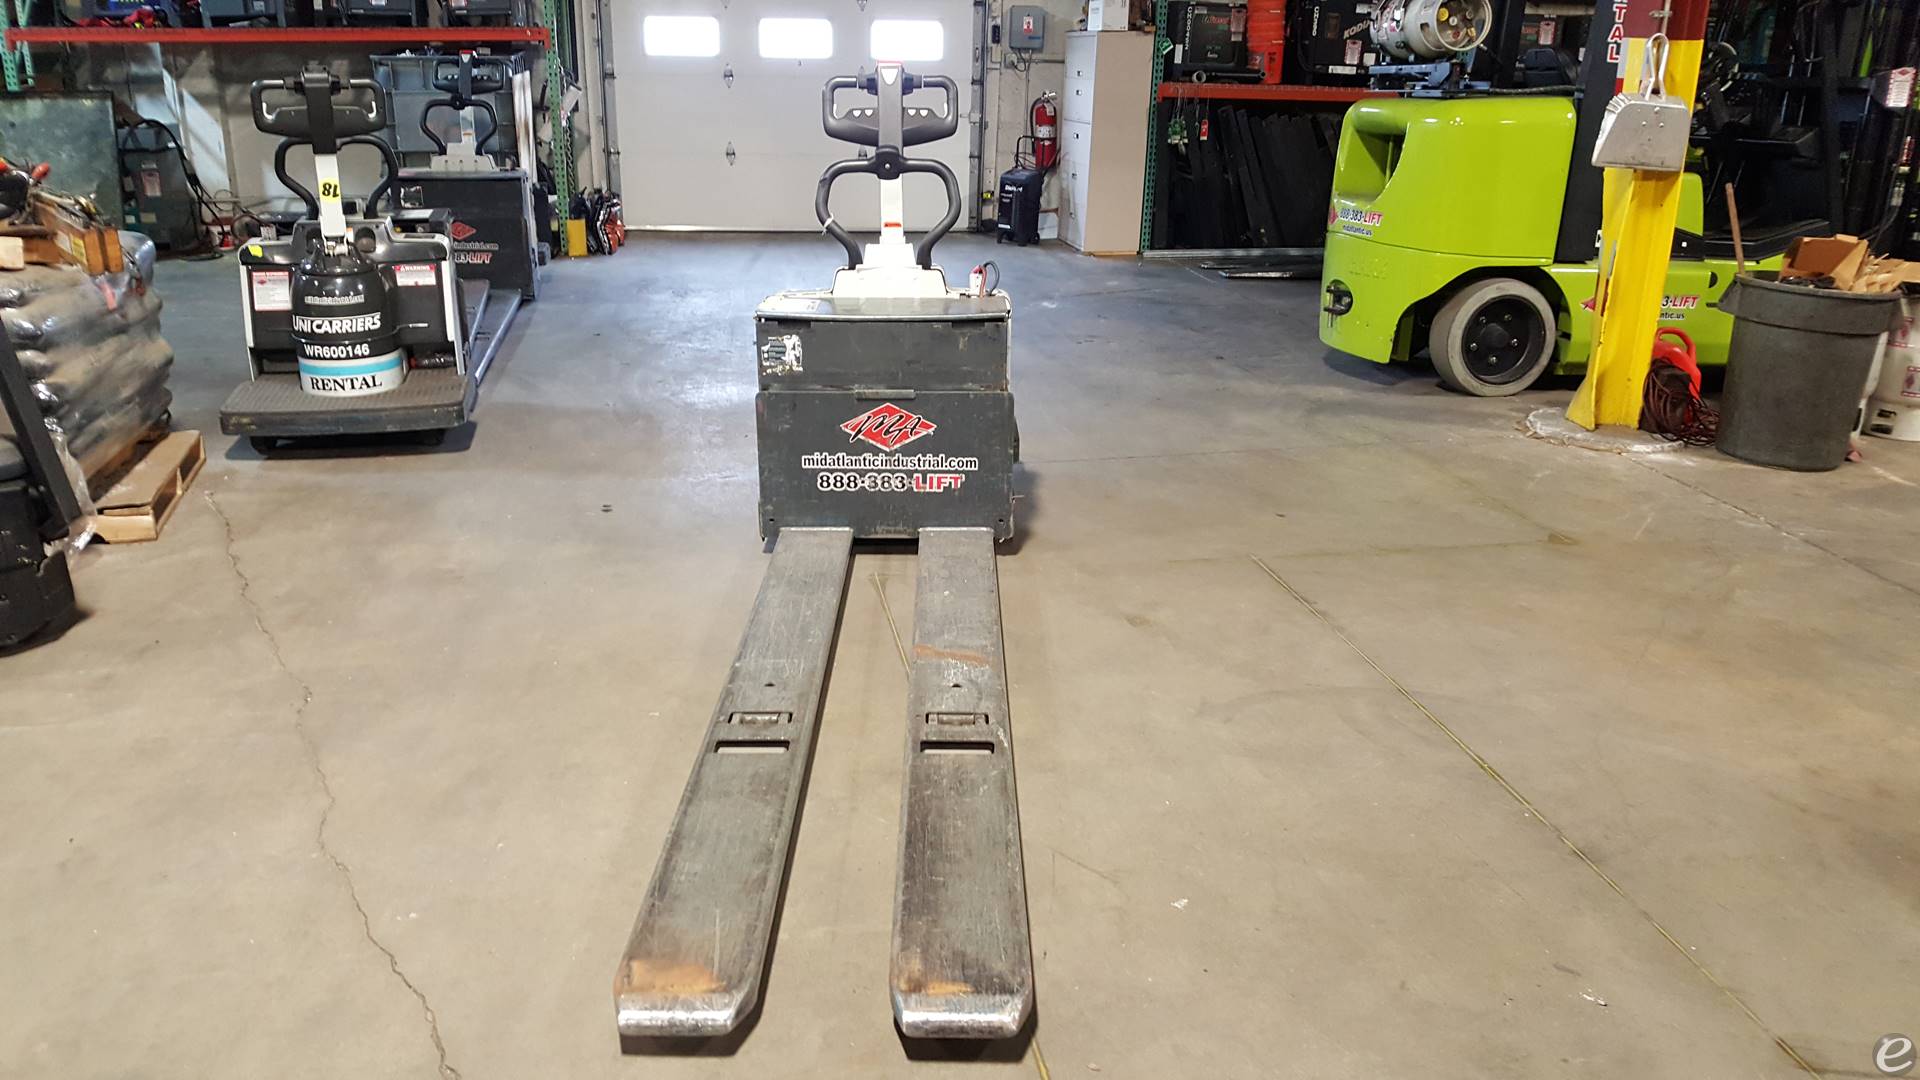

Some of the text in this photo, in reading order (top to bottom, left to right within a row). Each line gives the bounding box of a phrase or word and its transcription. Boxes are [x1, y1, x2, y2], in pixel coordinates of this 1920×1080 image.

[1607, 0, 1628, 62] TAL
[304, 343, 370, 358] WR600146
[310, 375, 383, 391] RENTAL
[802, 452, 978, 470] midatlanticindustrial.com
